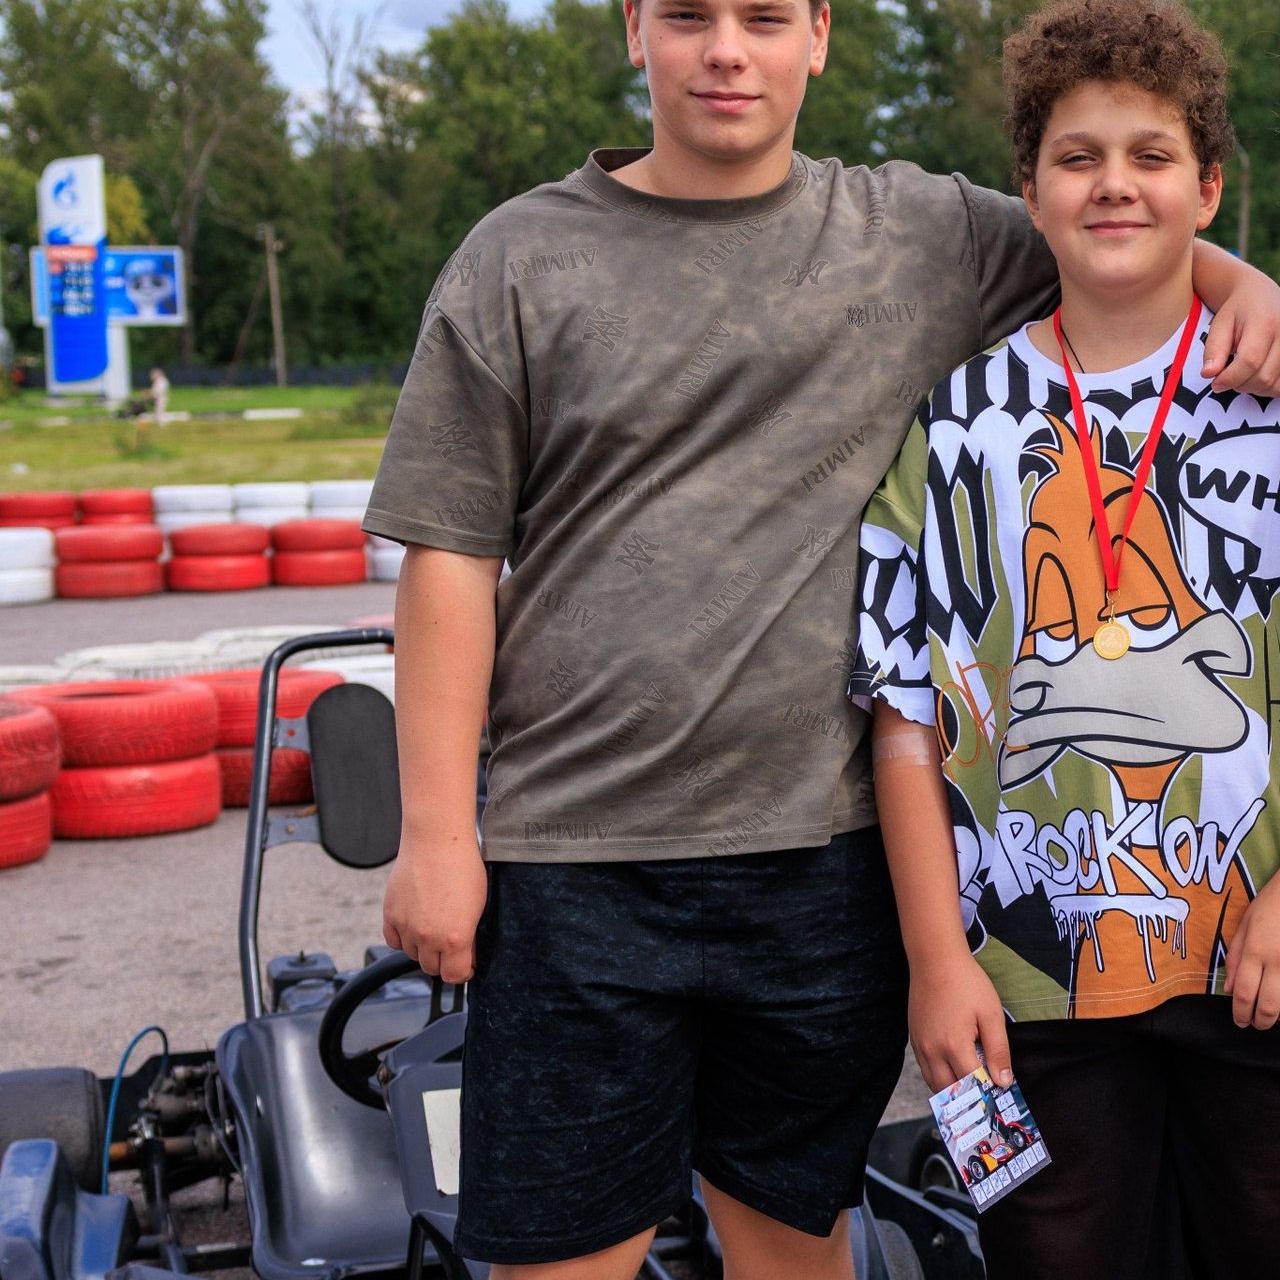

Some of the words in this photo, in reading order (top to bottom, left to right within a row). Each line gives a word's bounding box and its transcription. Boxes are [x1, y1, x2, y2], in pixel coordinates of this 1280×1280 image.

[509, 247, 599, 279] AIMRI
[693, 219, 765, 276] AIMRI
[674, 319, 732, 400] AIMRI
[799, 425, 867, 493] AIMRI
[537, 587, 598, 629] AIMR
[687, 559, 762, 640] AIMRI
[523, 820, 615, 841] AIMRI
[999, 801, 1168, 899] ROCK
[1163, 798, 1267, 893] ON
